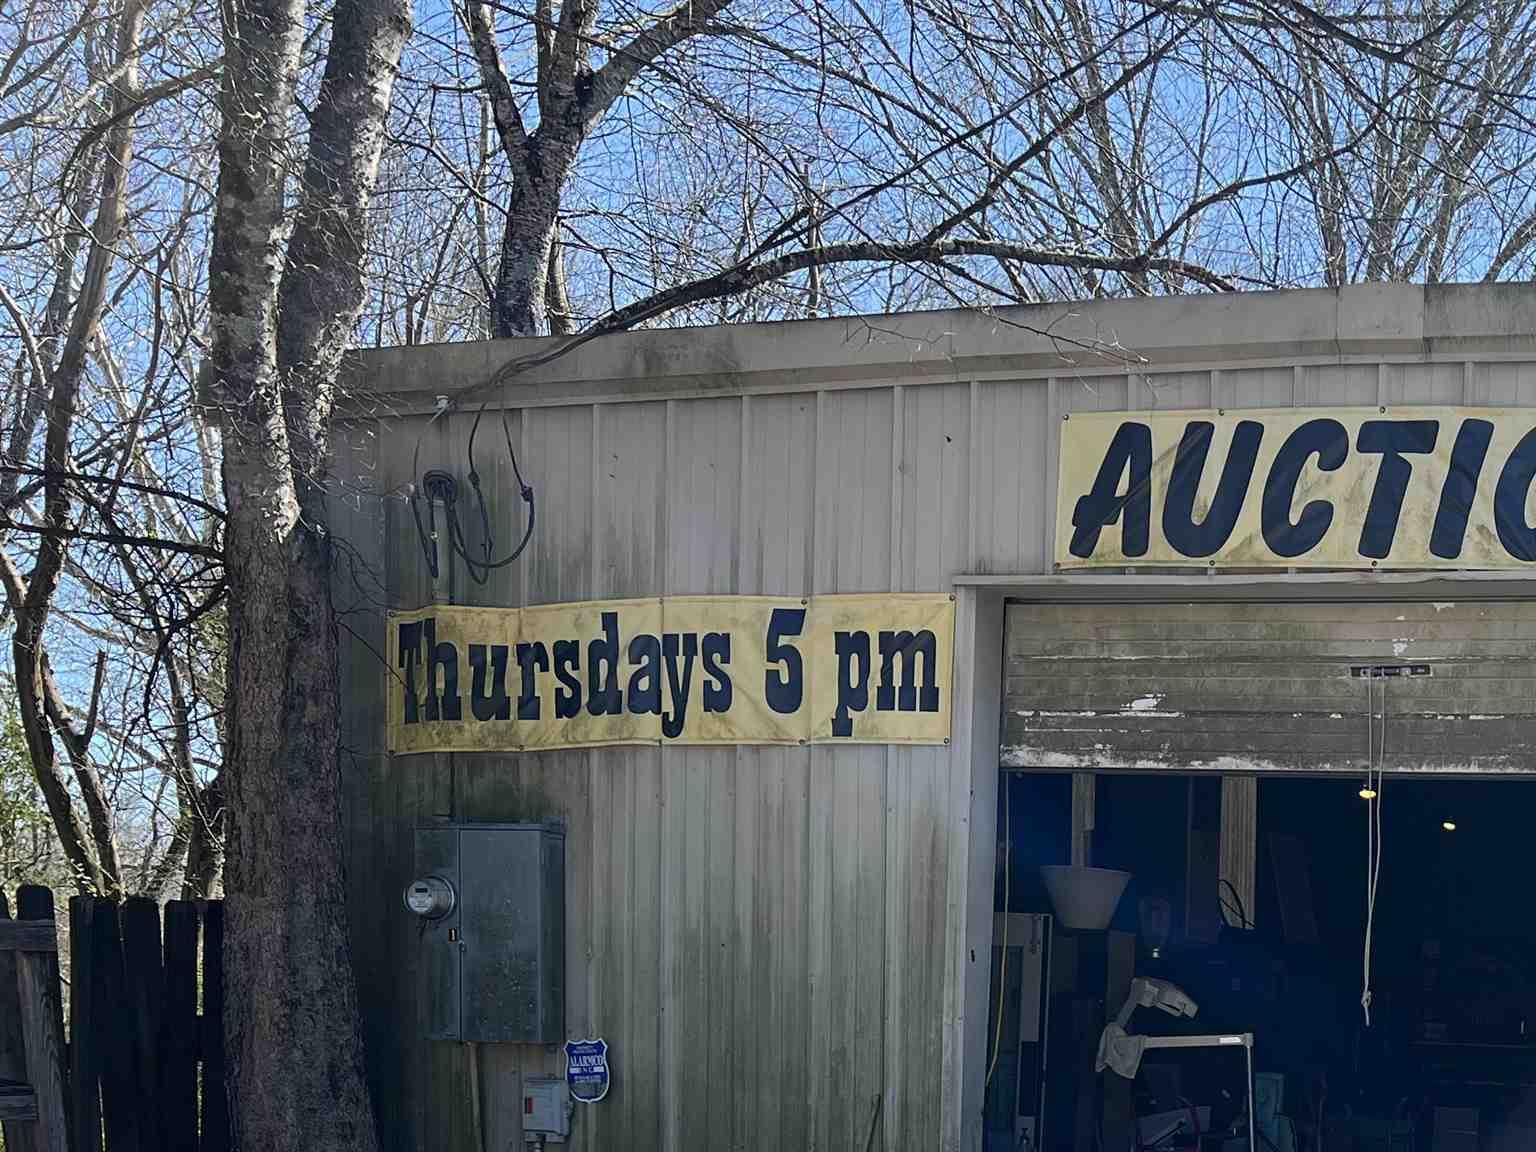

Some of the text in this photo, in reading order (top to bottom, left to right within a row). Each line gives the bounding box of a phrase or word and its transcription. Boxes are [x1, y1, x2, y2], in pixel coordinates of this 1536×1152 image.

[399, 608, 940, 738] Thursdays 5 pm
